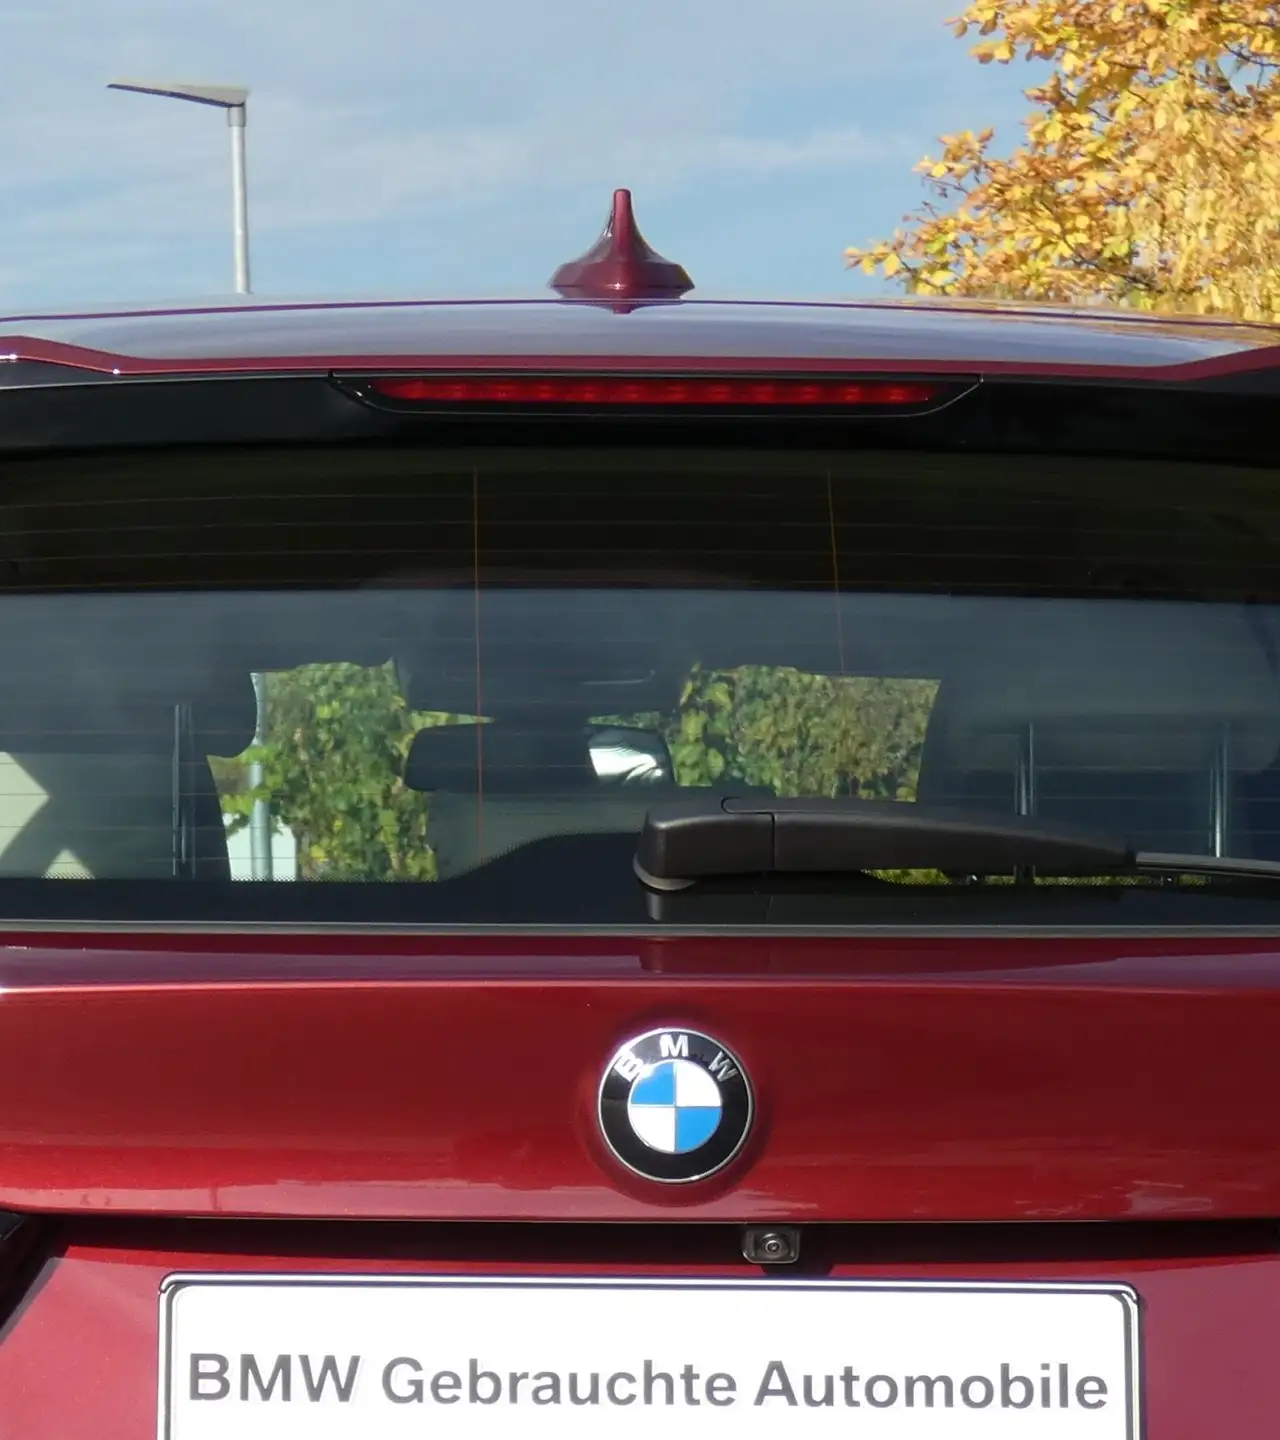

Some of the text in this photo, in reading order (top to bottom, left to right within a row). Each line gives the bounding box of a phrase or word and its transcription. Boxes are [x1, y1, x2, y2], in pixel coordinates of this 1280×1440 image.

[613, 1034, 739, 1083] BMW
[188, 1352, 1109, 1410] BMW Gebrauchte Automobile
